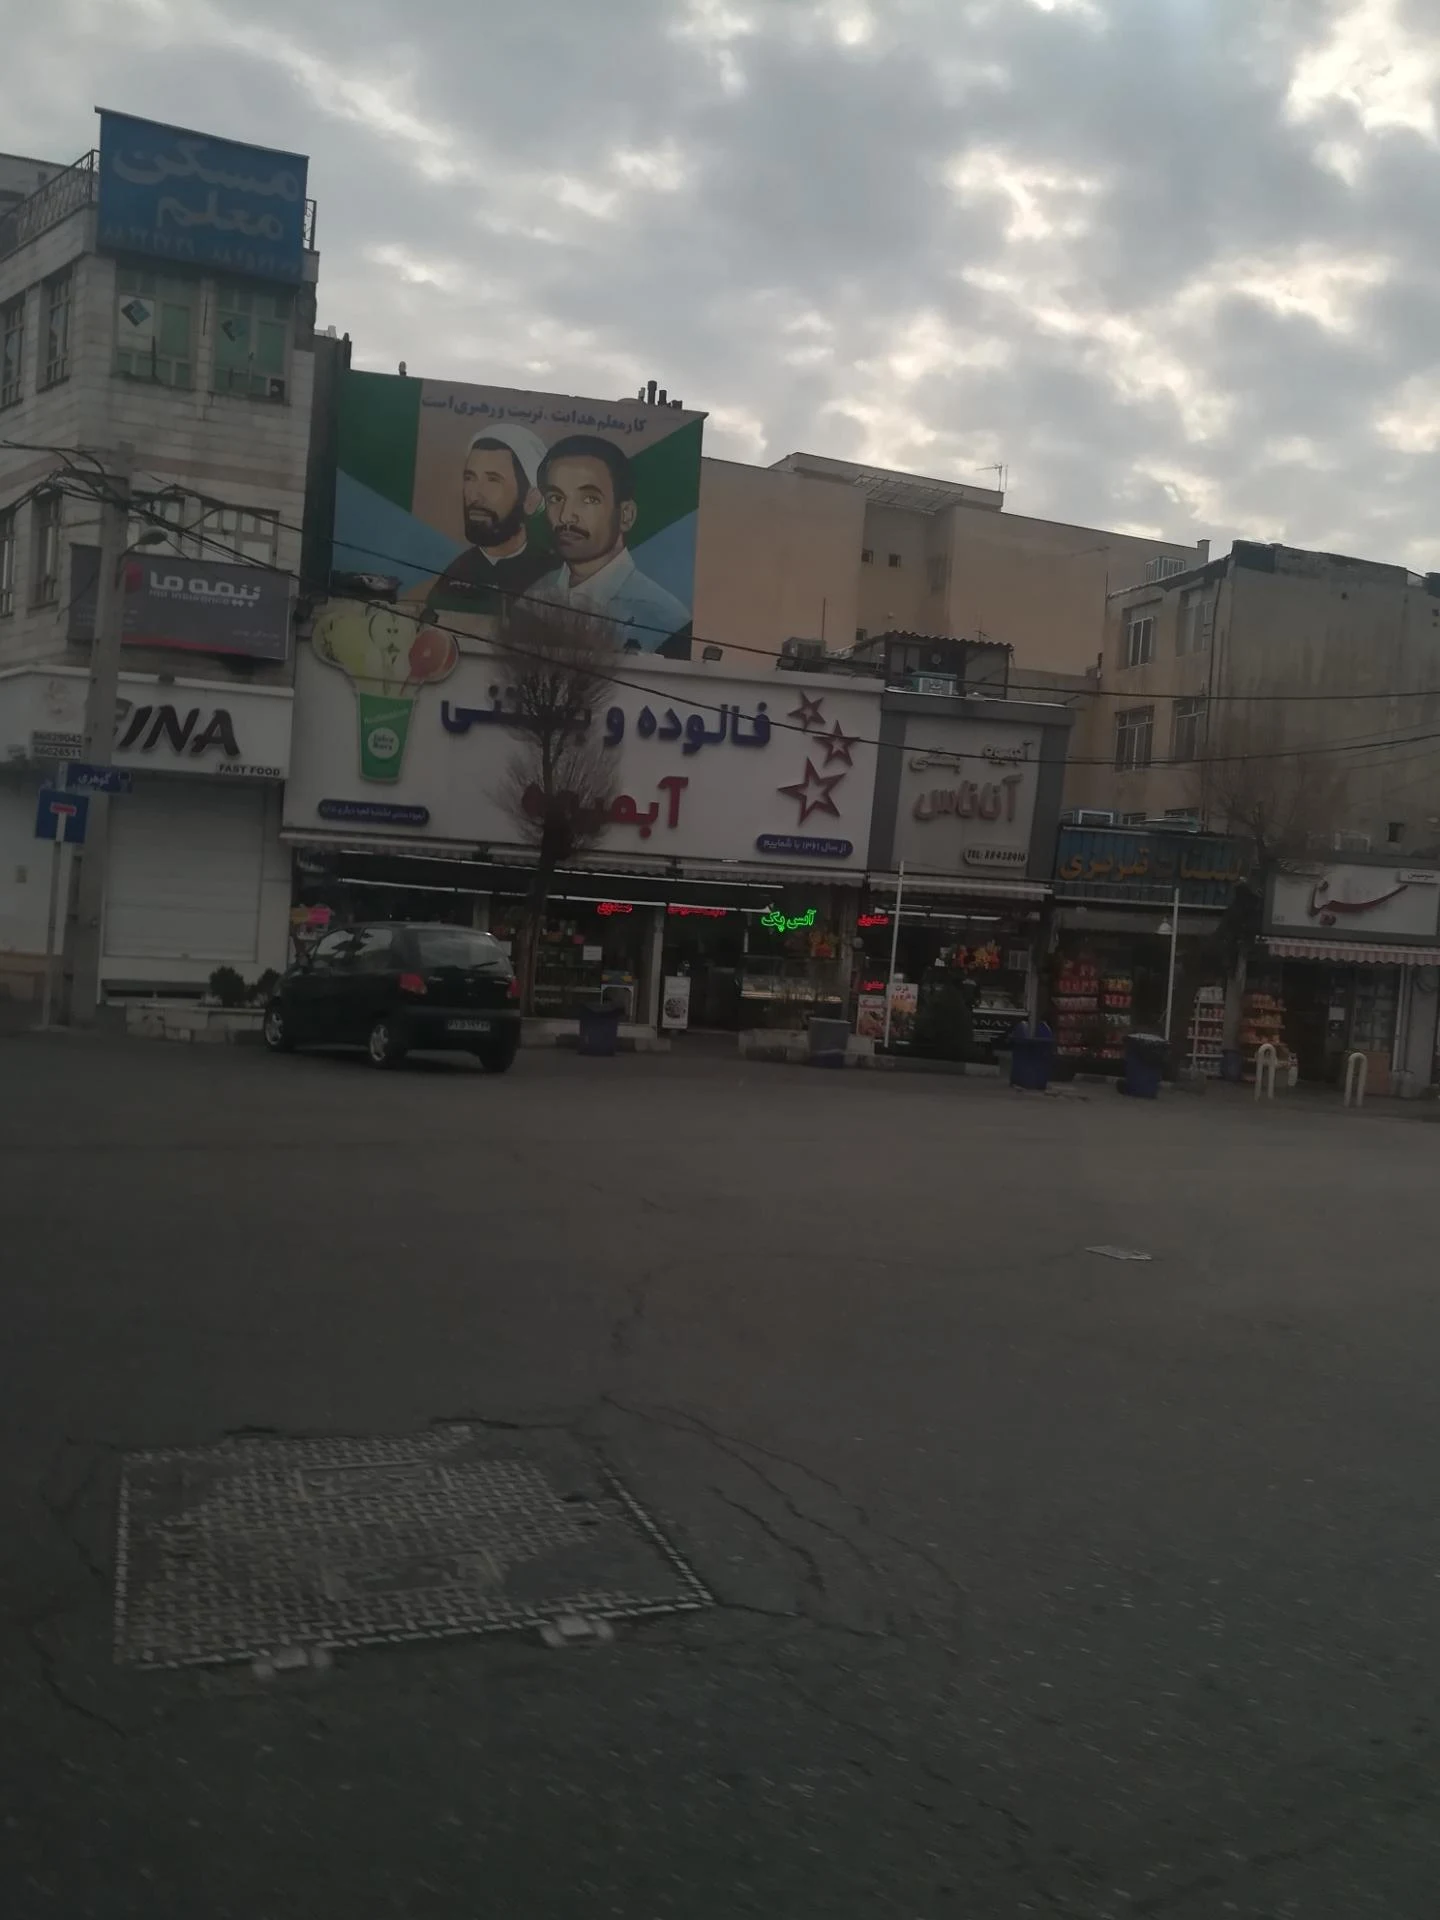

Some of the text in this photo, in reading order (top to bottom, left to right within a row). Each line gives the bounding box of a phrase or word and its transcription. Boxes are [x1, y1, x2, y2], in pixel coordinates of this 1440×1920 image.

[112, 140, 300, 203] مسکن
[157, 190, 284, 242] معلم
[602, 705, 625, 746] و
[637, 701, 771, 755] فالوده
[218, 764, 281, 776] FAST FOOD
[911, 773, 1025, 823] آناناس
